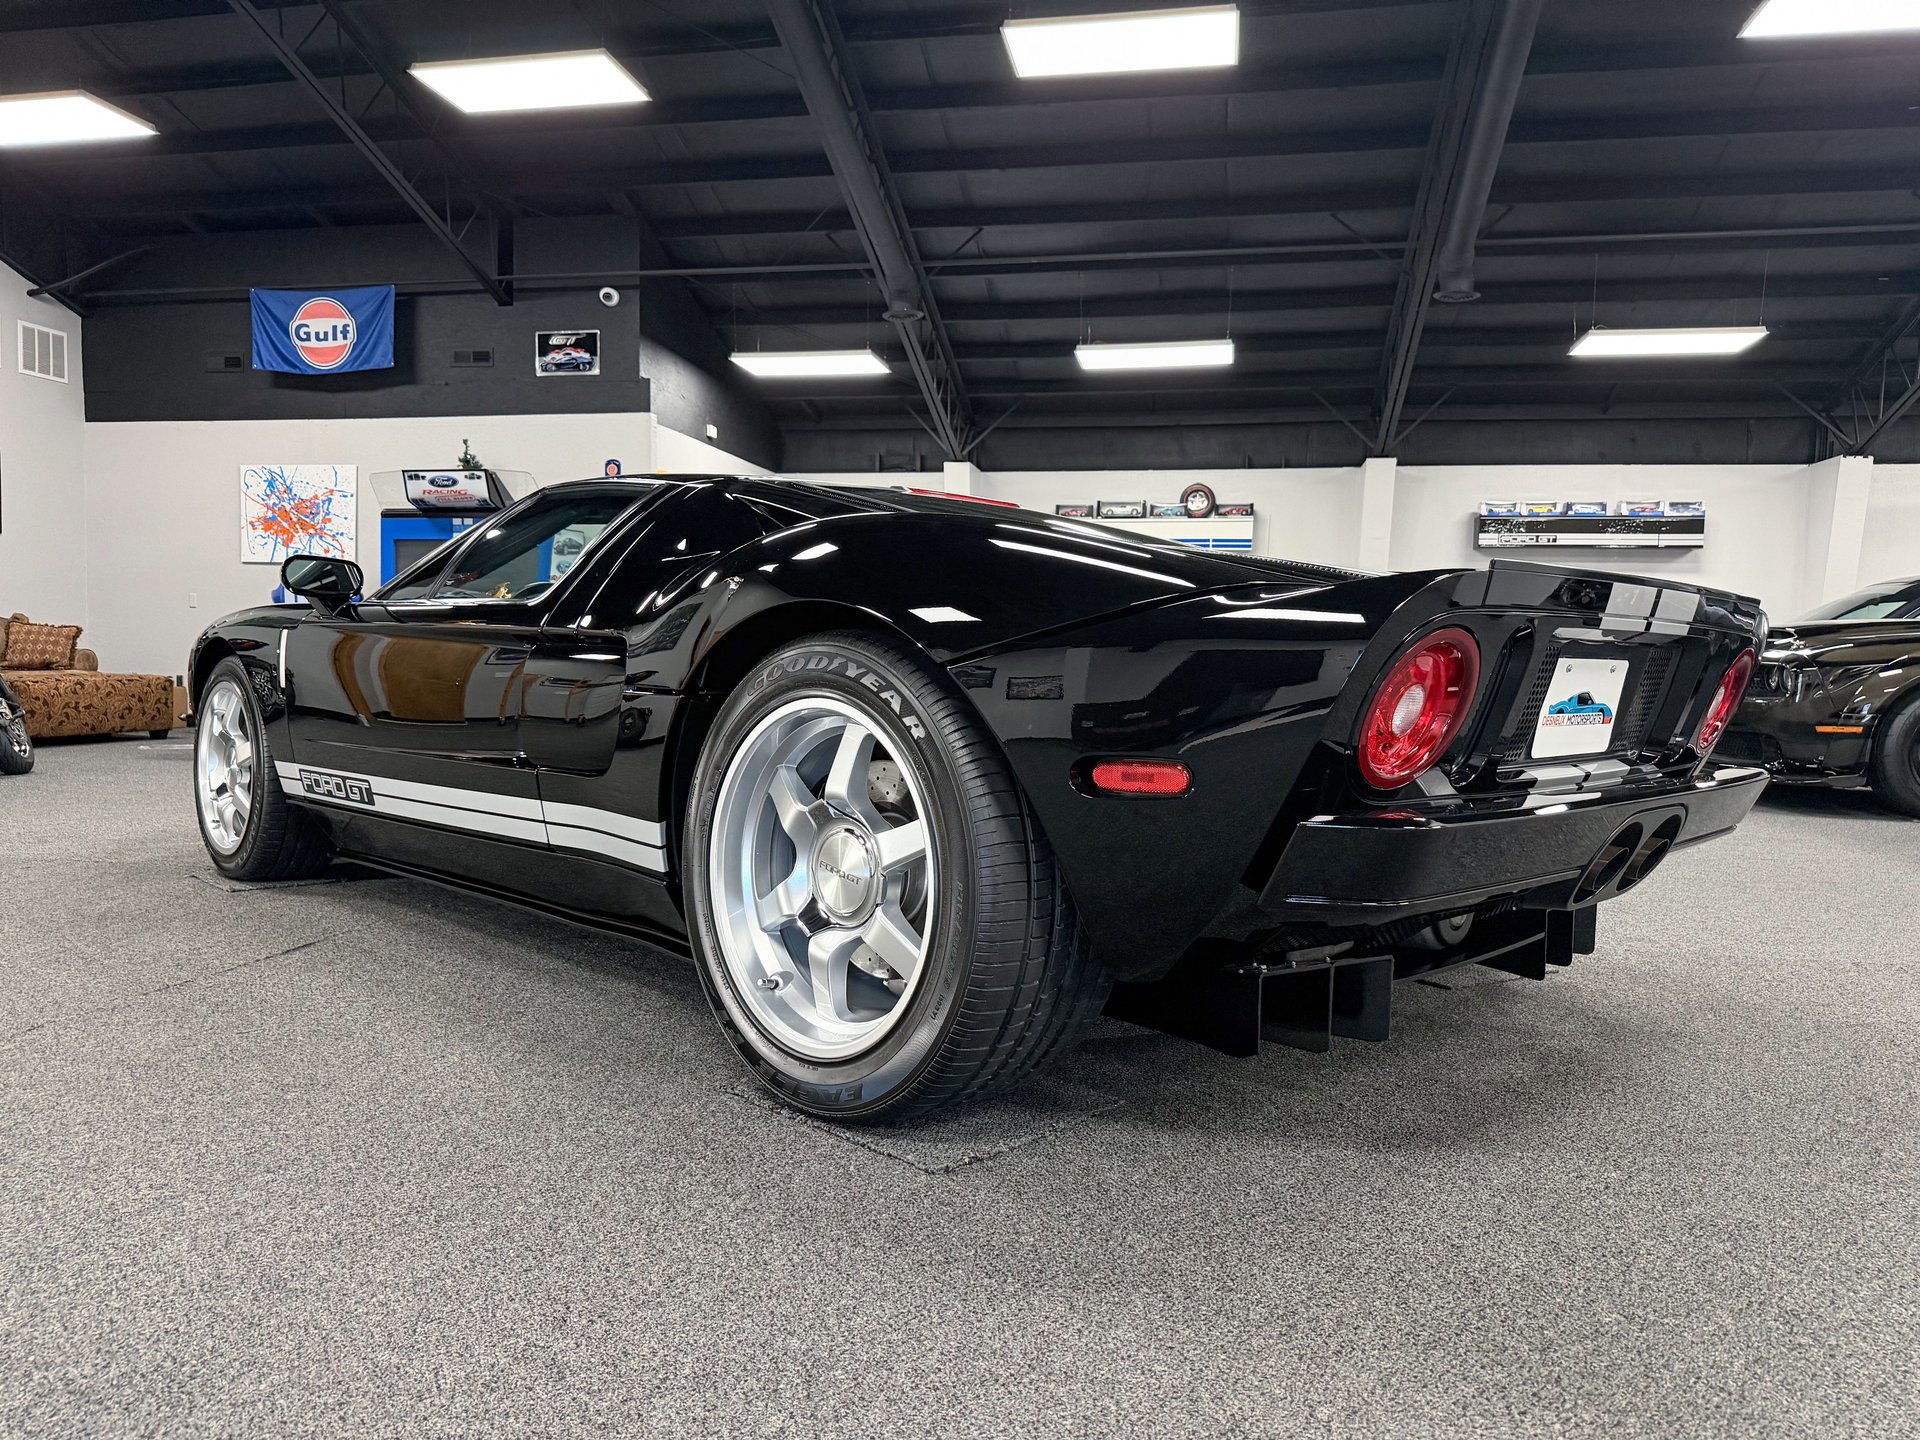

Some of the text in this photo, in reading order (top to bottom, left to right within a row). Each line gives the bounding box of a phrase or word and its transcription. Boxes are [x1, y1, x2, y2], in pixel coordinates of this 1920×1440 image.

[294, 323, 351, 342] Gulf
[433, 477, 453, 487] Ford
[748, 655, 926, 741] GOODYEAR
[1567, 713, 1602, 725] MOTORSPORTS
[301, 772, 370, 803] FORD GT
[846, 872, 862, 886] GT
